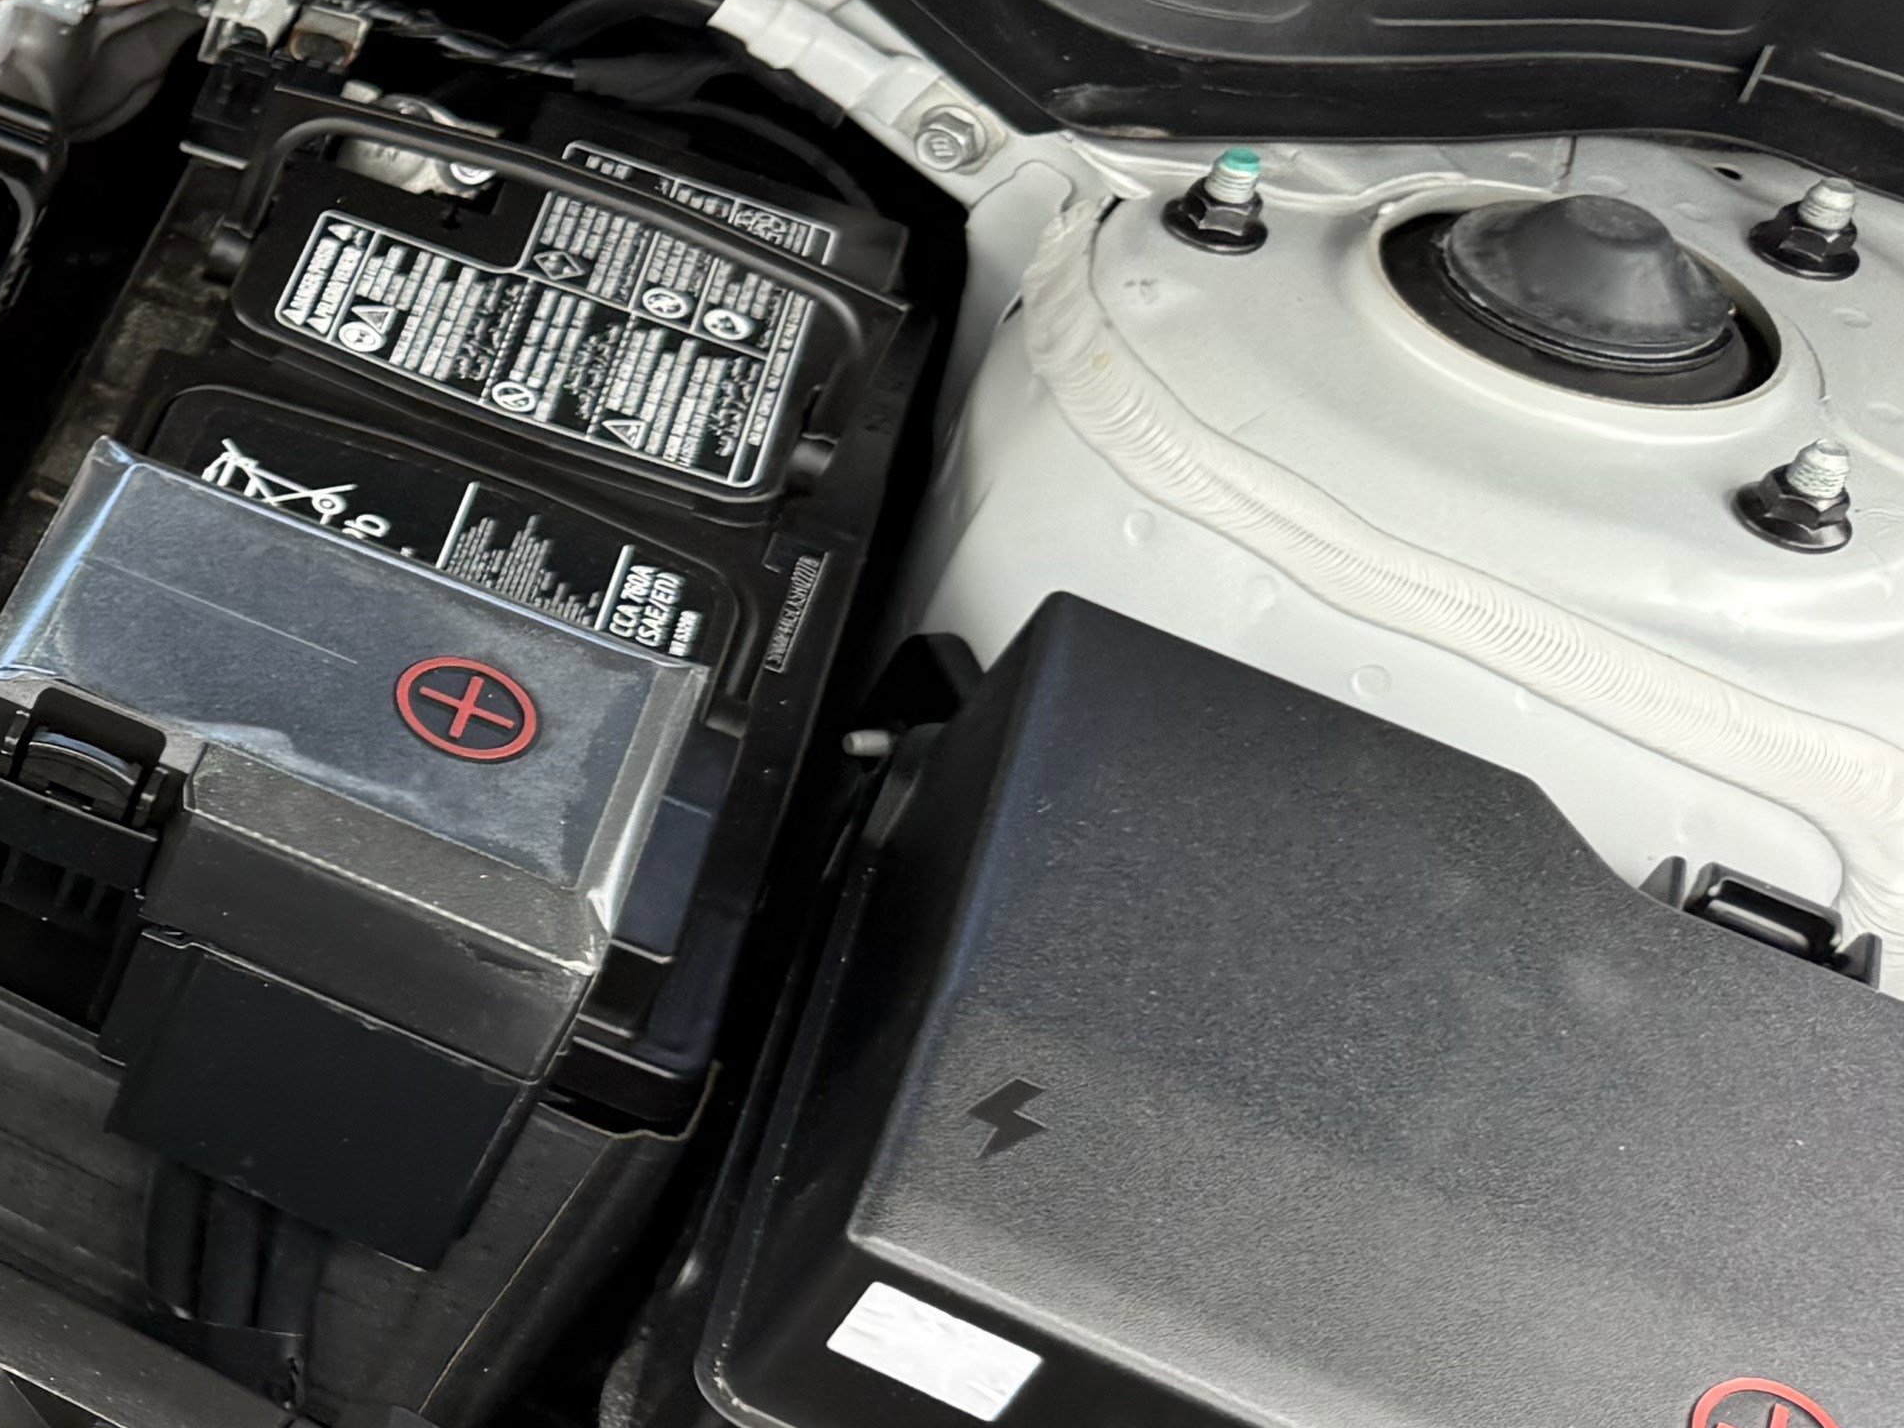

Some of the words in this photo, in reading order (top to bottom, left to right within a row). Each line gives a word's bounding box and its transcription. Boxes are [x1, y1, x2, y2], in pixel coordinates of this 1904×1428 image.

[619, 559, 659, 607] 760A
[608, 599, 643, 639] CCA
[632, 568, 688, 650] (SAE/EN)
